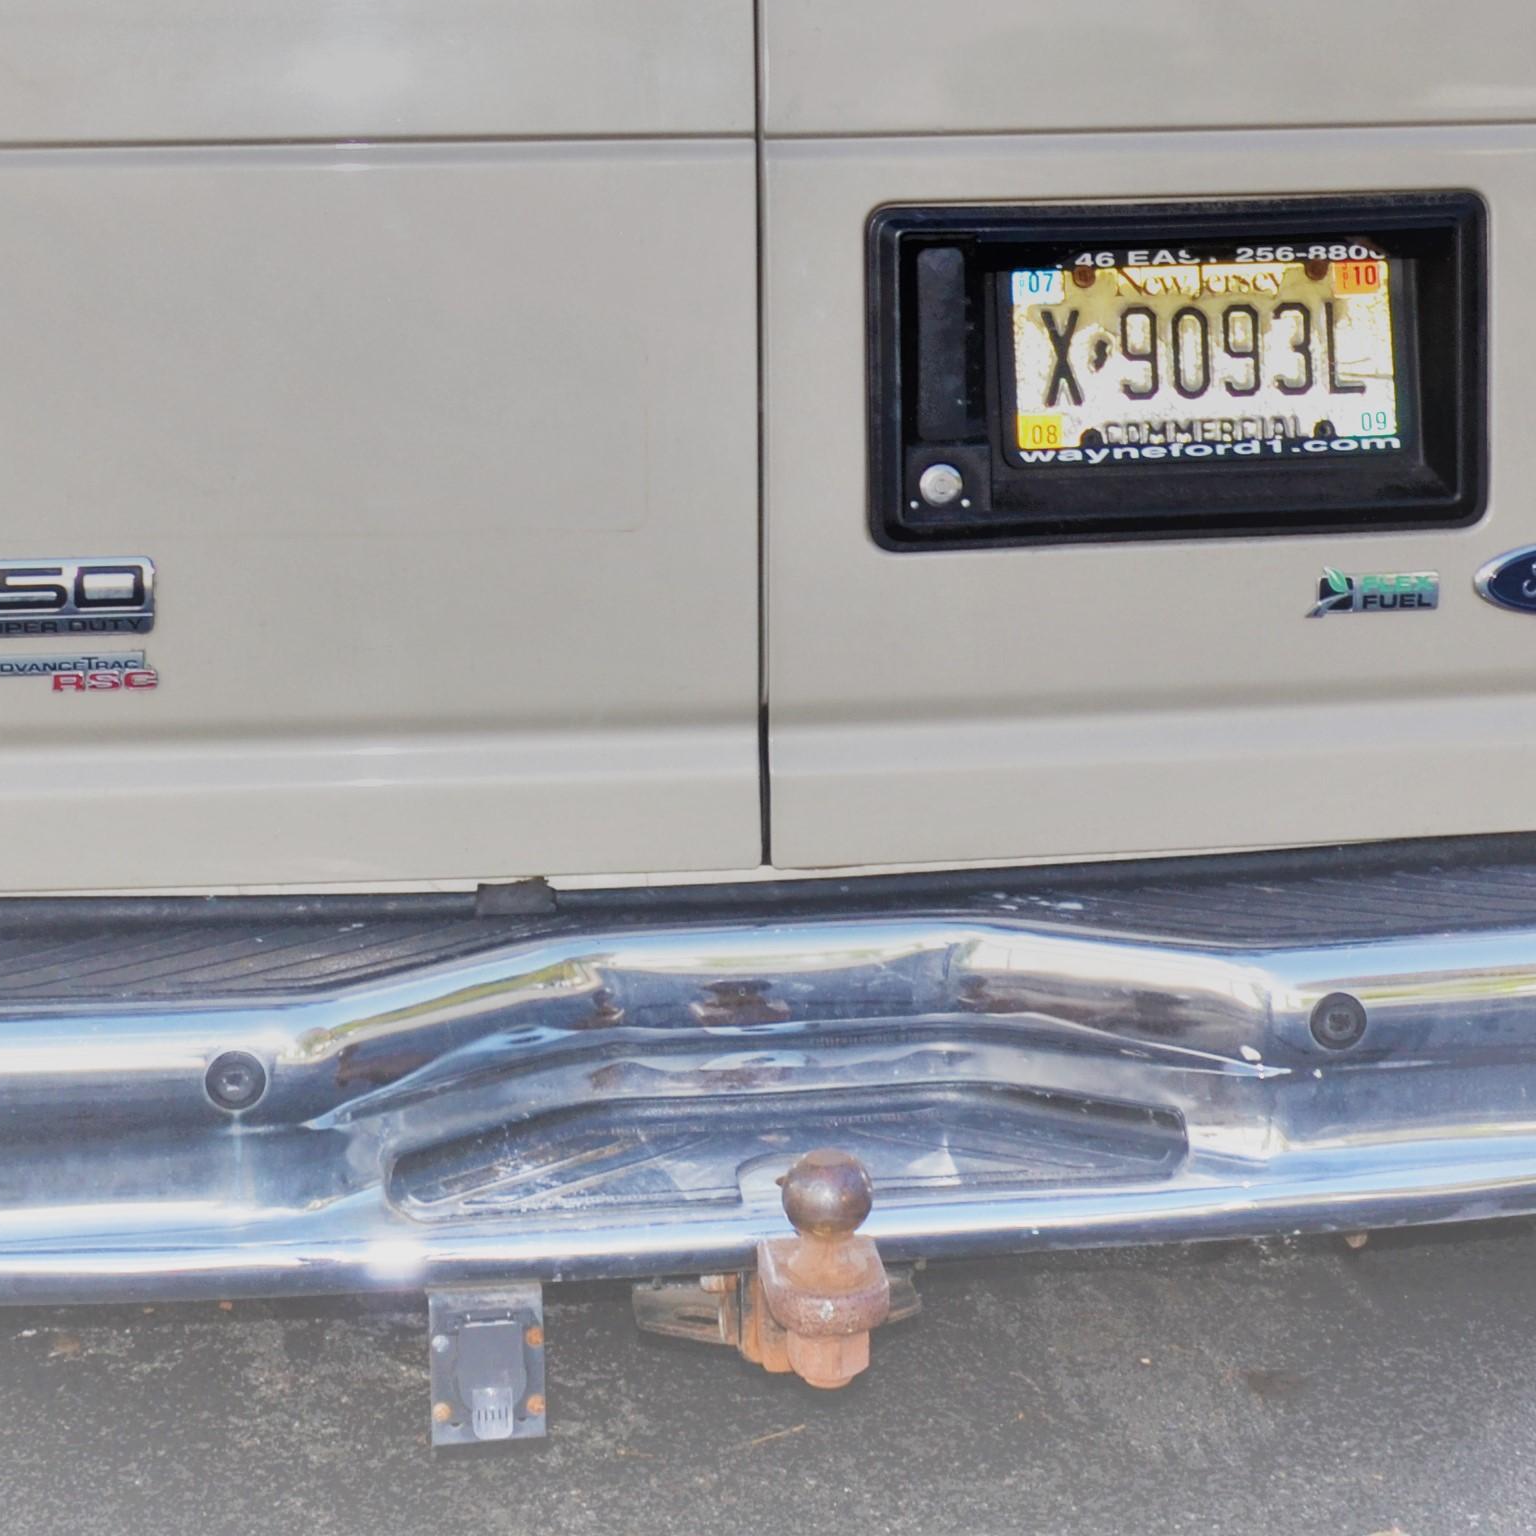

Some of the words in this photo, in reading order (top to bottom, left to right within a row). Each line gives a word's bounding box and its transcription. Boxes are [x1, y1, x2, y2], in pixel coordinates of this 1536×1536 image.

[1075, 252, 1115, 267] 46
[1127, 249, 1217, 266] EAS
[1028, 271, 1054, 293] 07
[1115, 266, 1191, 297] New
[1190, 264, 1285, 301] Jersey
[1353, 264, 1377, 286] 10
[1104, 414, 1311, 445] COMMERCIAL
[1361, 412, 1387, 432] 09
[1032, 424, 1059, 446] 08
[1018, 436, 1402, 464] wayneford1.com
[1363, 576, 1436, 593] FLEX
[1362, 593, 1433, 609] FUEL
[68, 616, 143, 633] DUTY
[51, 671, 157, 692] RSC
